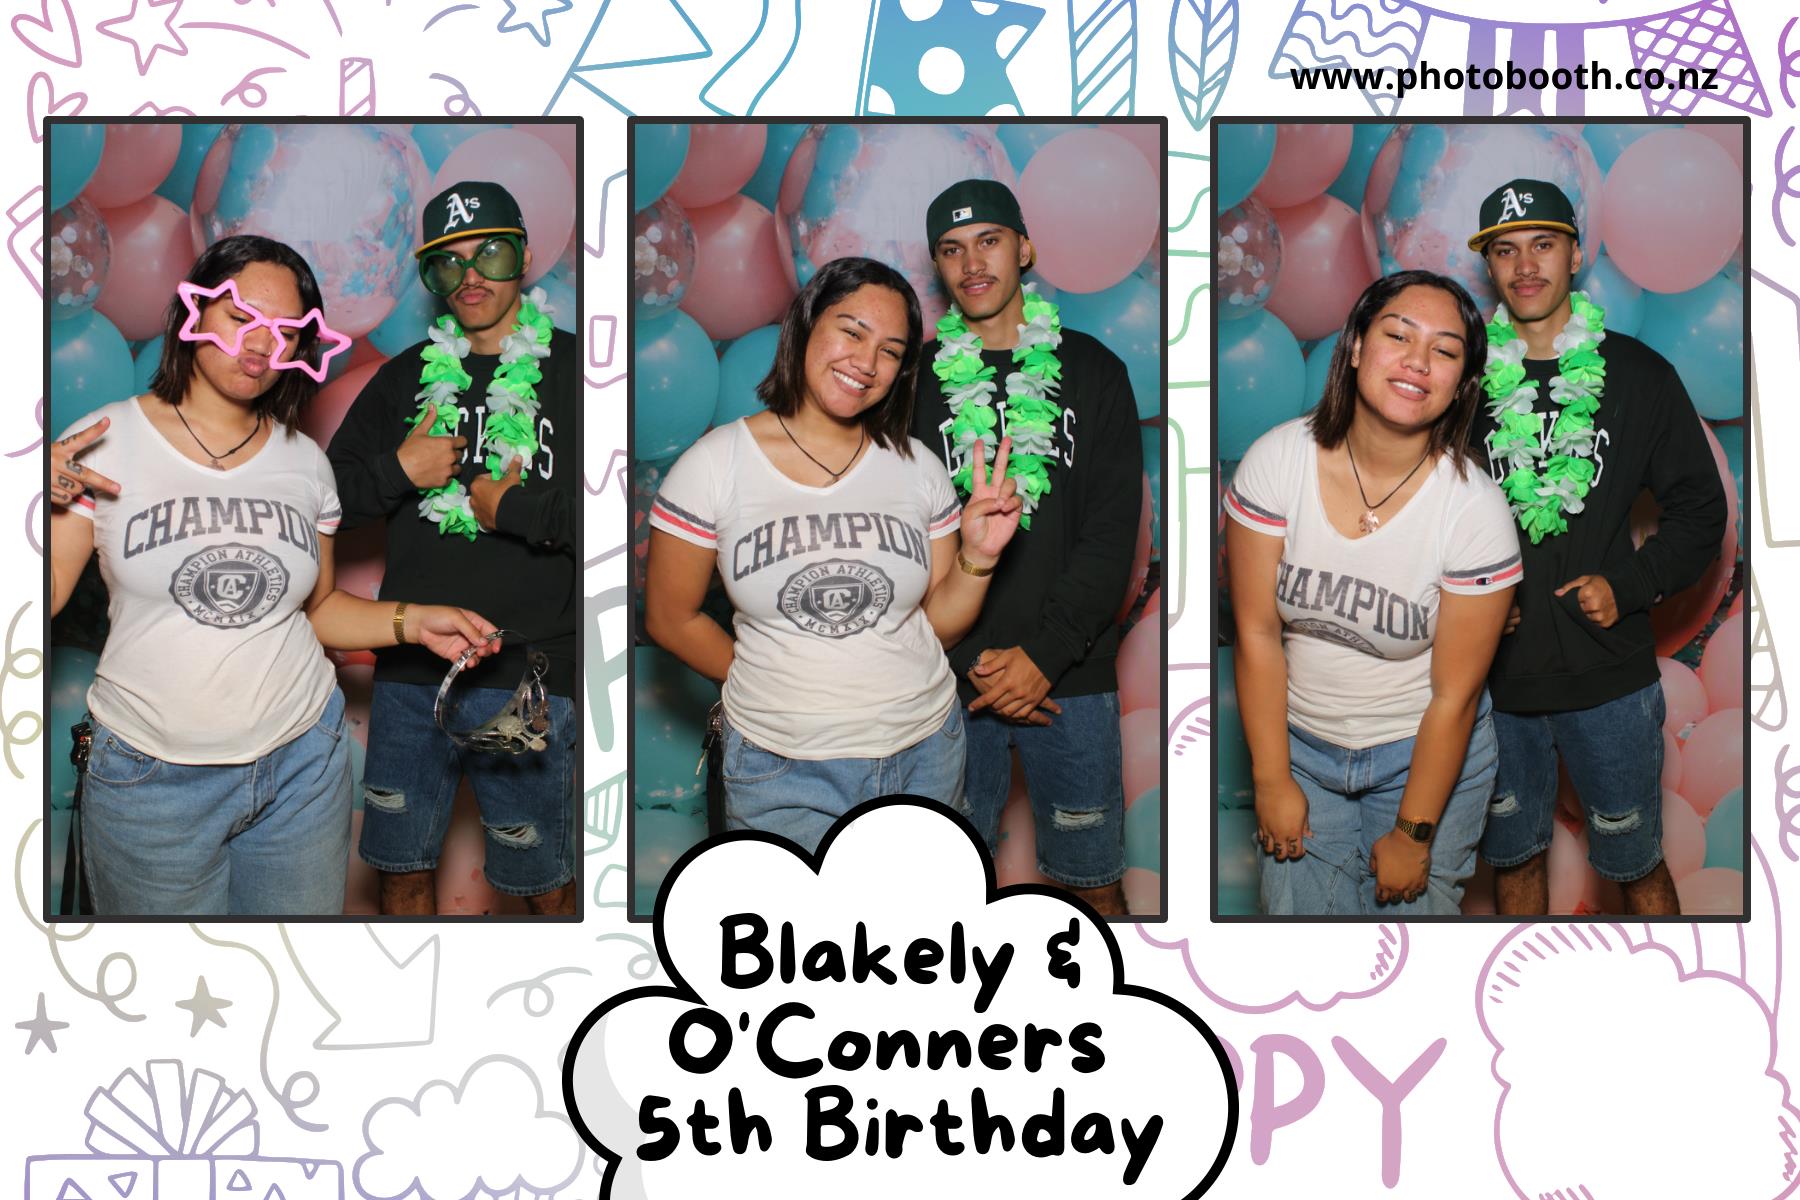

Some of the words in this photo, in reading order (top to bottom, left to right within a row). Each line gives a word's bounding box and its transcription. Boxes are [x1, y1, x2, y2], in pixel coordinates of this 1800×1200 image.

[444, 193, 480, 234] A's
[1498, 188, 1534, 224] A's
[124, 497, 320, 566] CHAMPION
[733, 512, 928, 581] CHAMPION
[178, 549, 228, 598] CHAMPION
[235, 549, 282, 602] ATHLETICS
[785, 566, 830, 614] CHAMPION
[837, 565, 888, 608] ATHLETICS
[1277, 560, 1430, 641] HAMPION
[804, 615, 870, 634] MCMXIX
